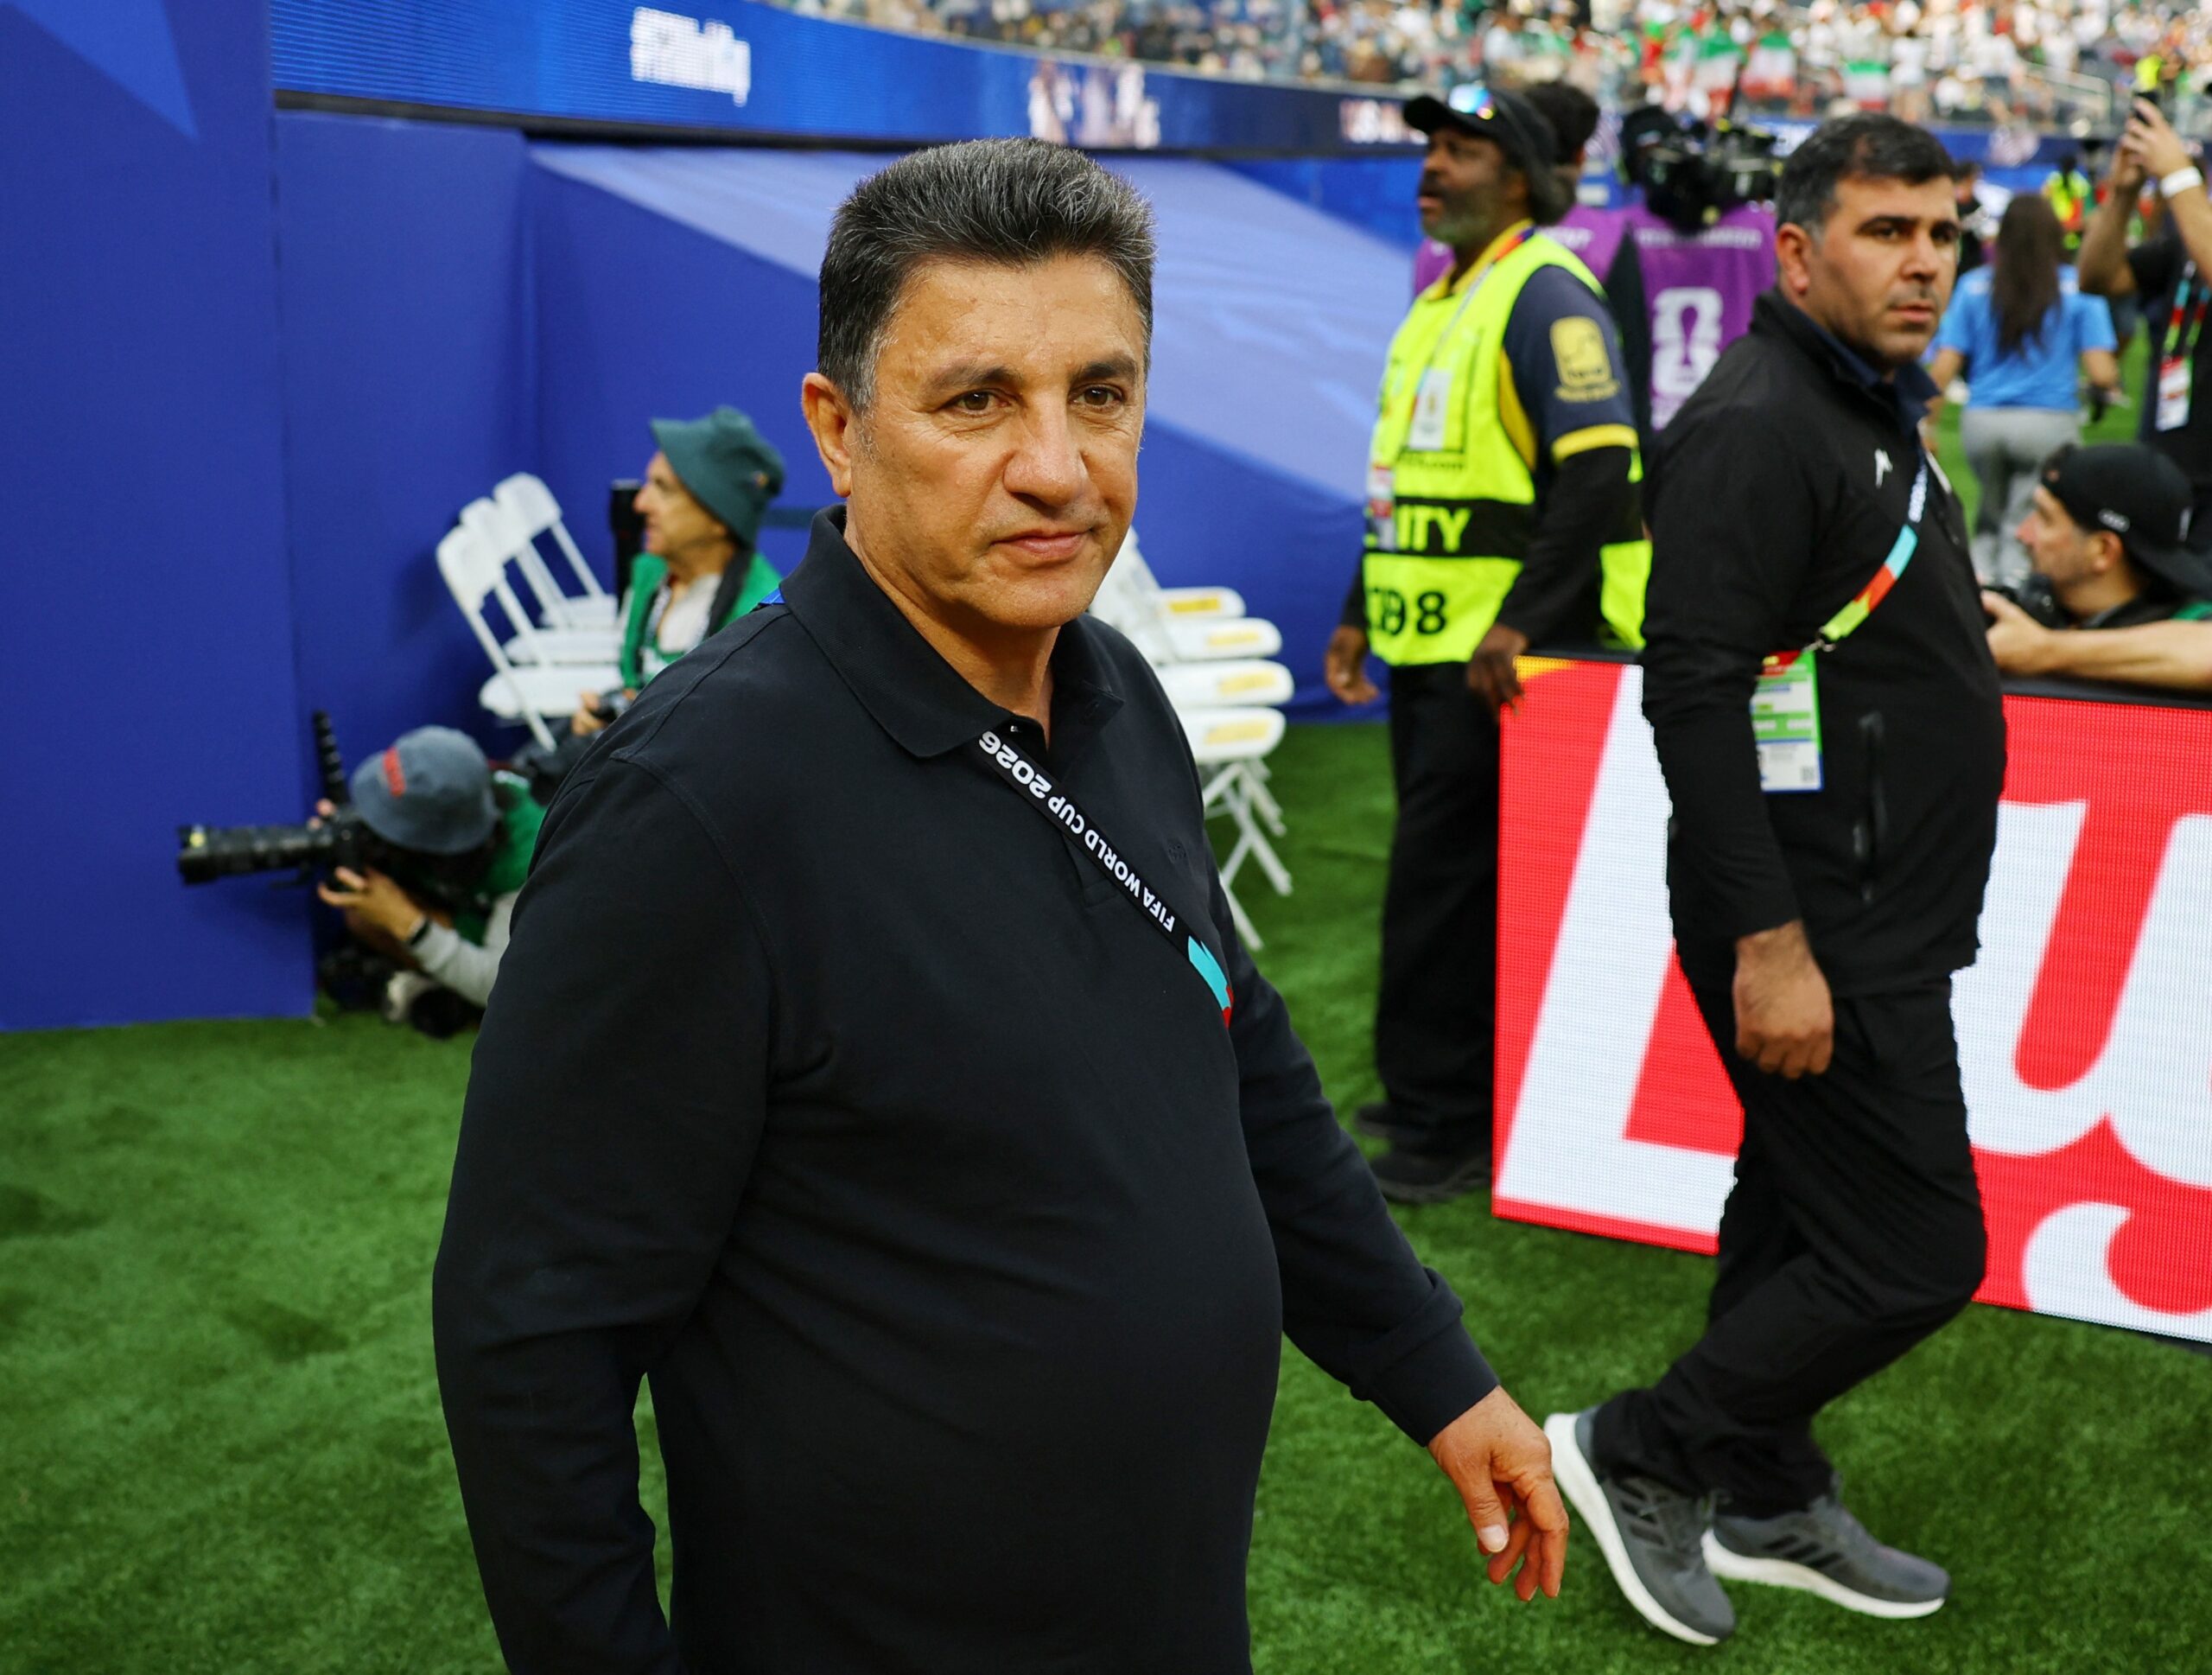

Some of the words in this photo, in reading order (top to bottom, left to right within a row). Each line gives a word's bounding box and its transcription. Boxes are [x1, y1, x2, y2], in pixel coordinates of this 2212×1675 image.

[978, 731, 1052, 799] 2026
[1047, 796, 1085, 834] CUP
[1084, 829, 1141, 898] WORLD
[1143, 887, 1175, 933] FIFA
